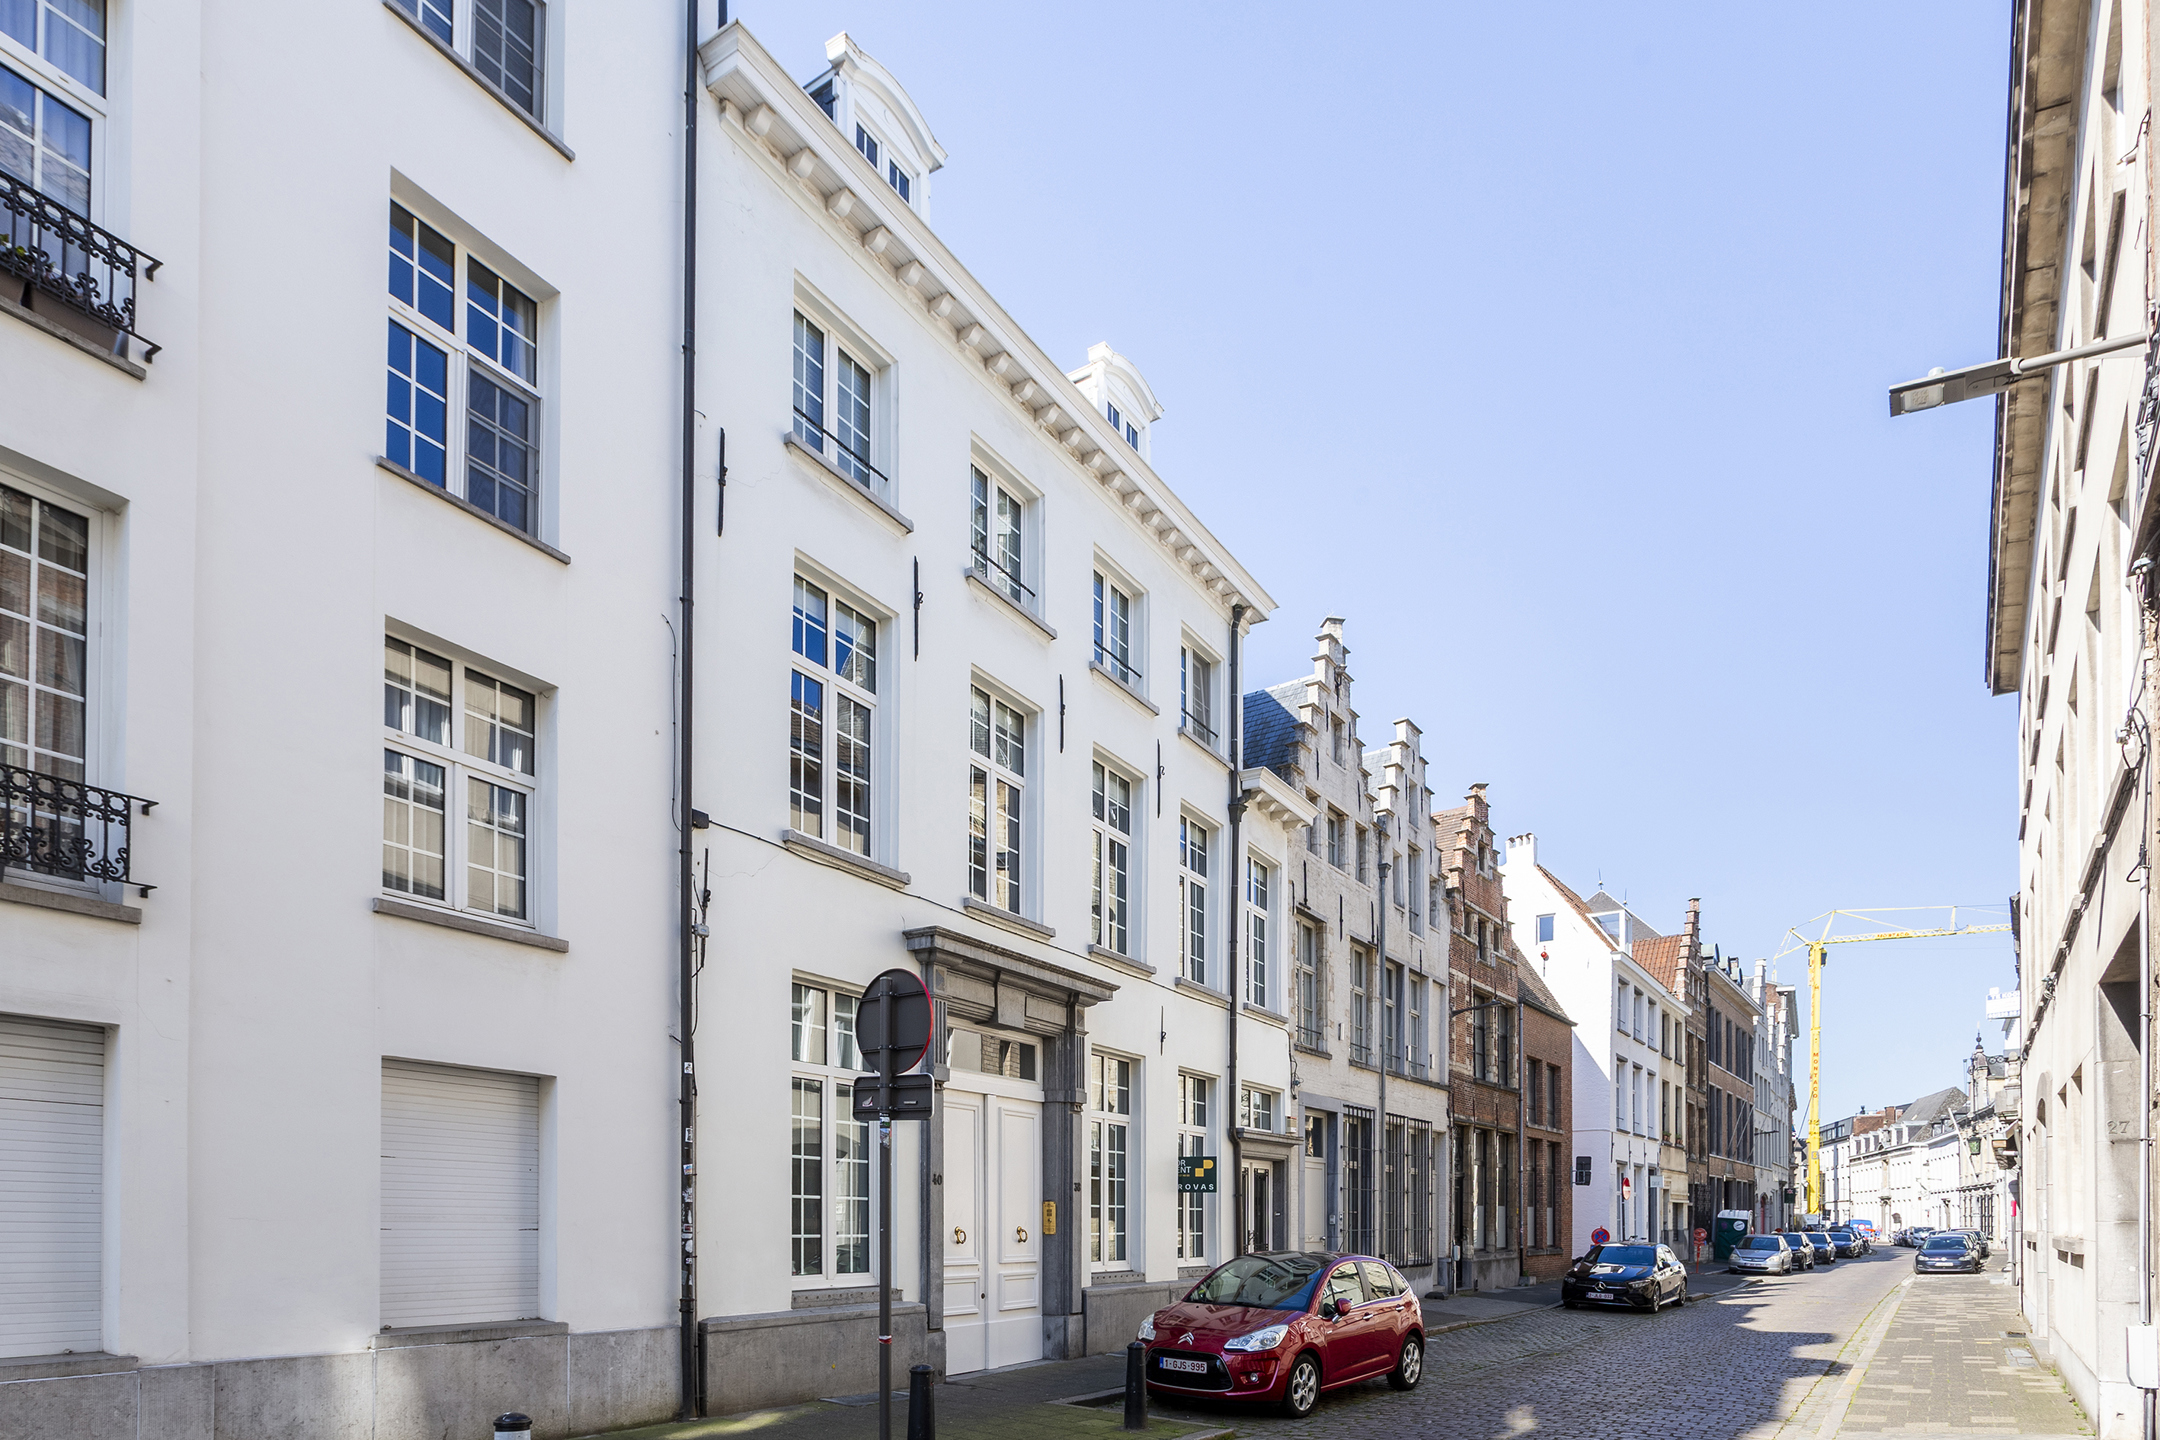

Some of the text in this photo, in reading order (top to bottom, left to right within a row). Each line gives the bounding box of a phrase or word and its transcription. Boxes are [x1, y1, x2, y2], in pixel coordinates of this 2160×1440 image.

[2107, 1120, 2130, 1134] 27
[932, 1174, 943, 1185] 40
[1165, 1359, 1206, 1372] 1-GJS-995
